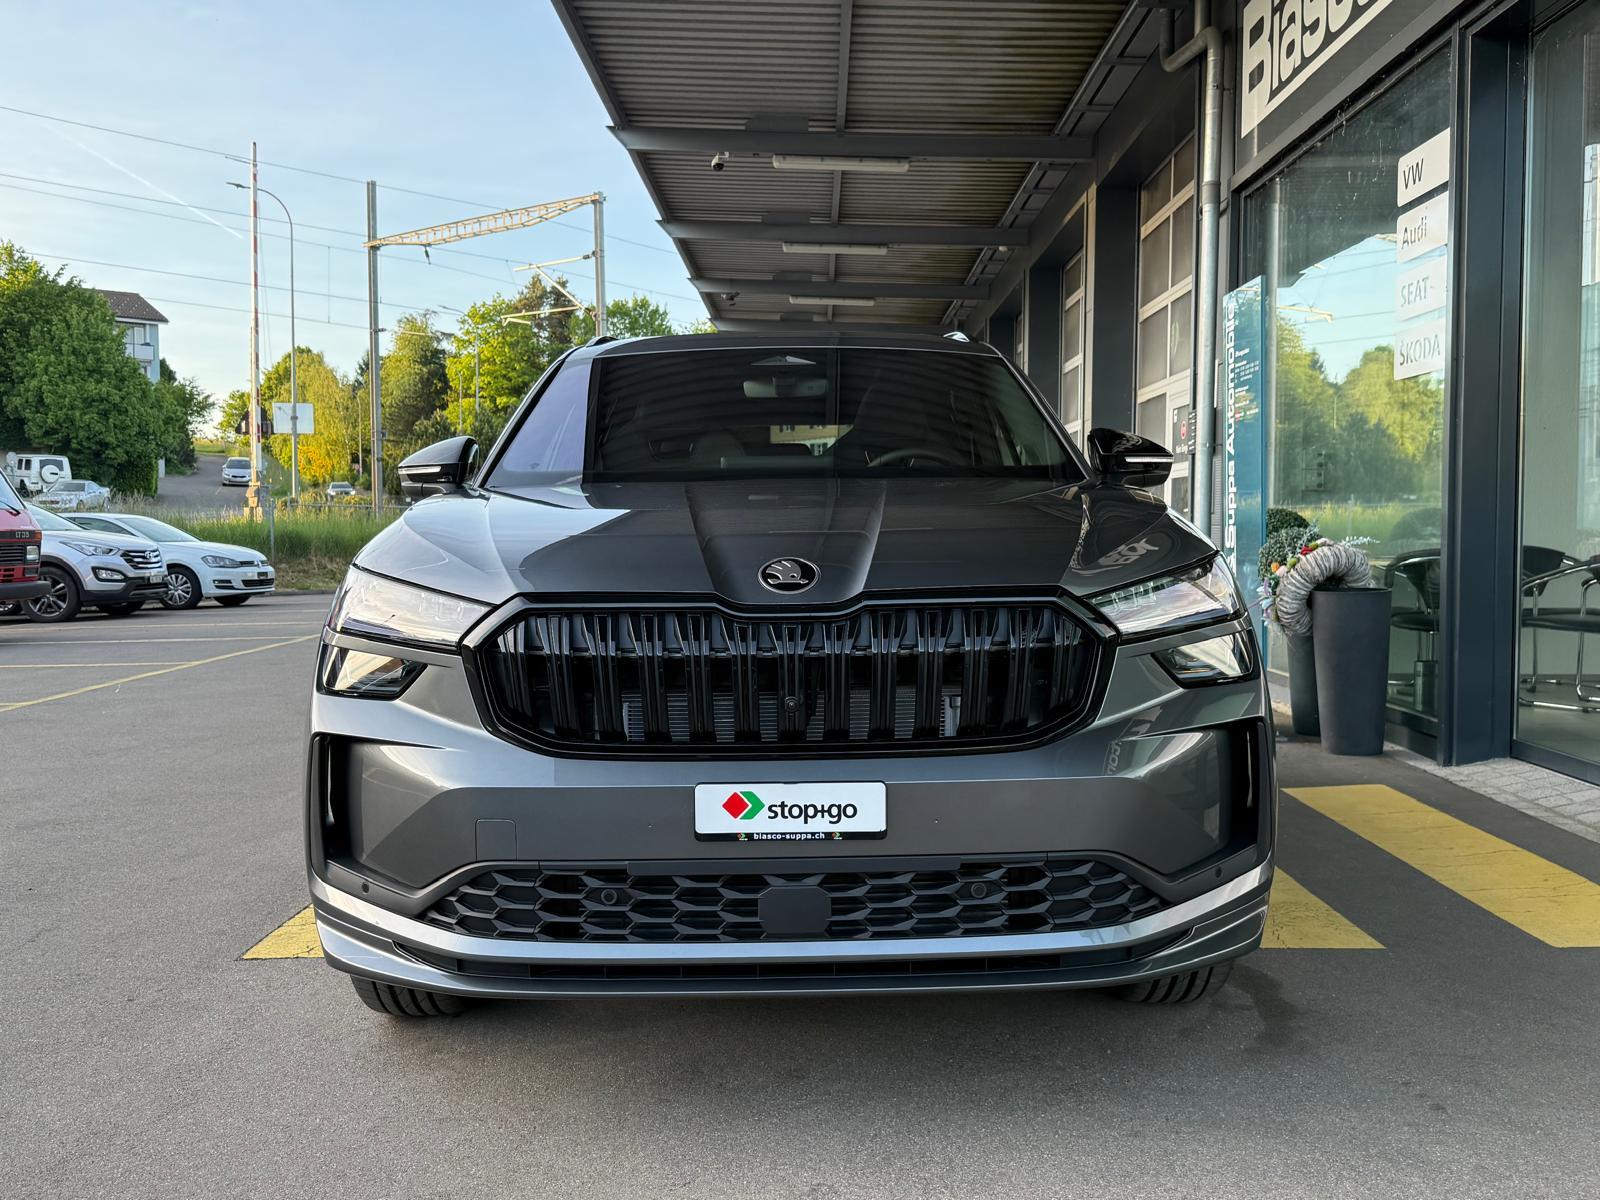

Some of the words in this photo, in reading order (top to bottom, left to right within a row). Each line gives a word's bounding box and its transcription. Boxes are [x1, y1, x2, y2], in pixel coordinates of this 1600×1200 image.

[1403, 158, 1423, 190] VW
[1401, 216, 1427, 249] Audi
[1401, 276, 1429, 307] SEAT
[767, 801, 858, 824] stop+go
[753, 832, 825, 840] biasco-suppa.ch
